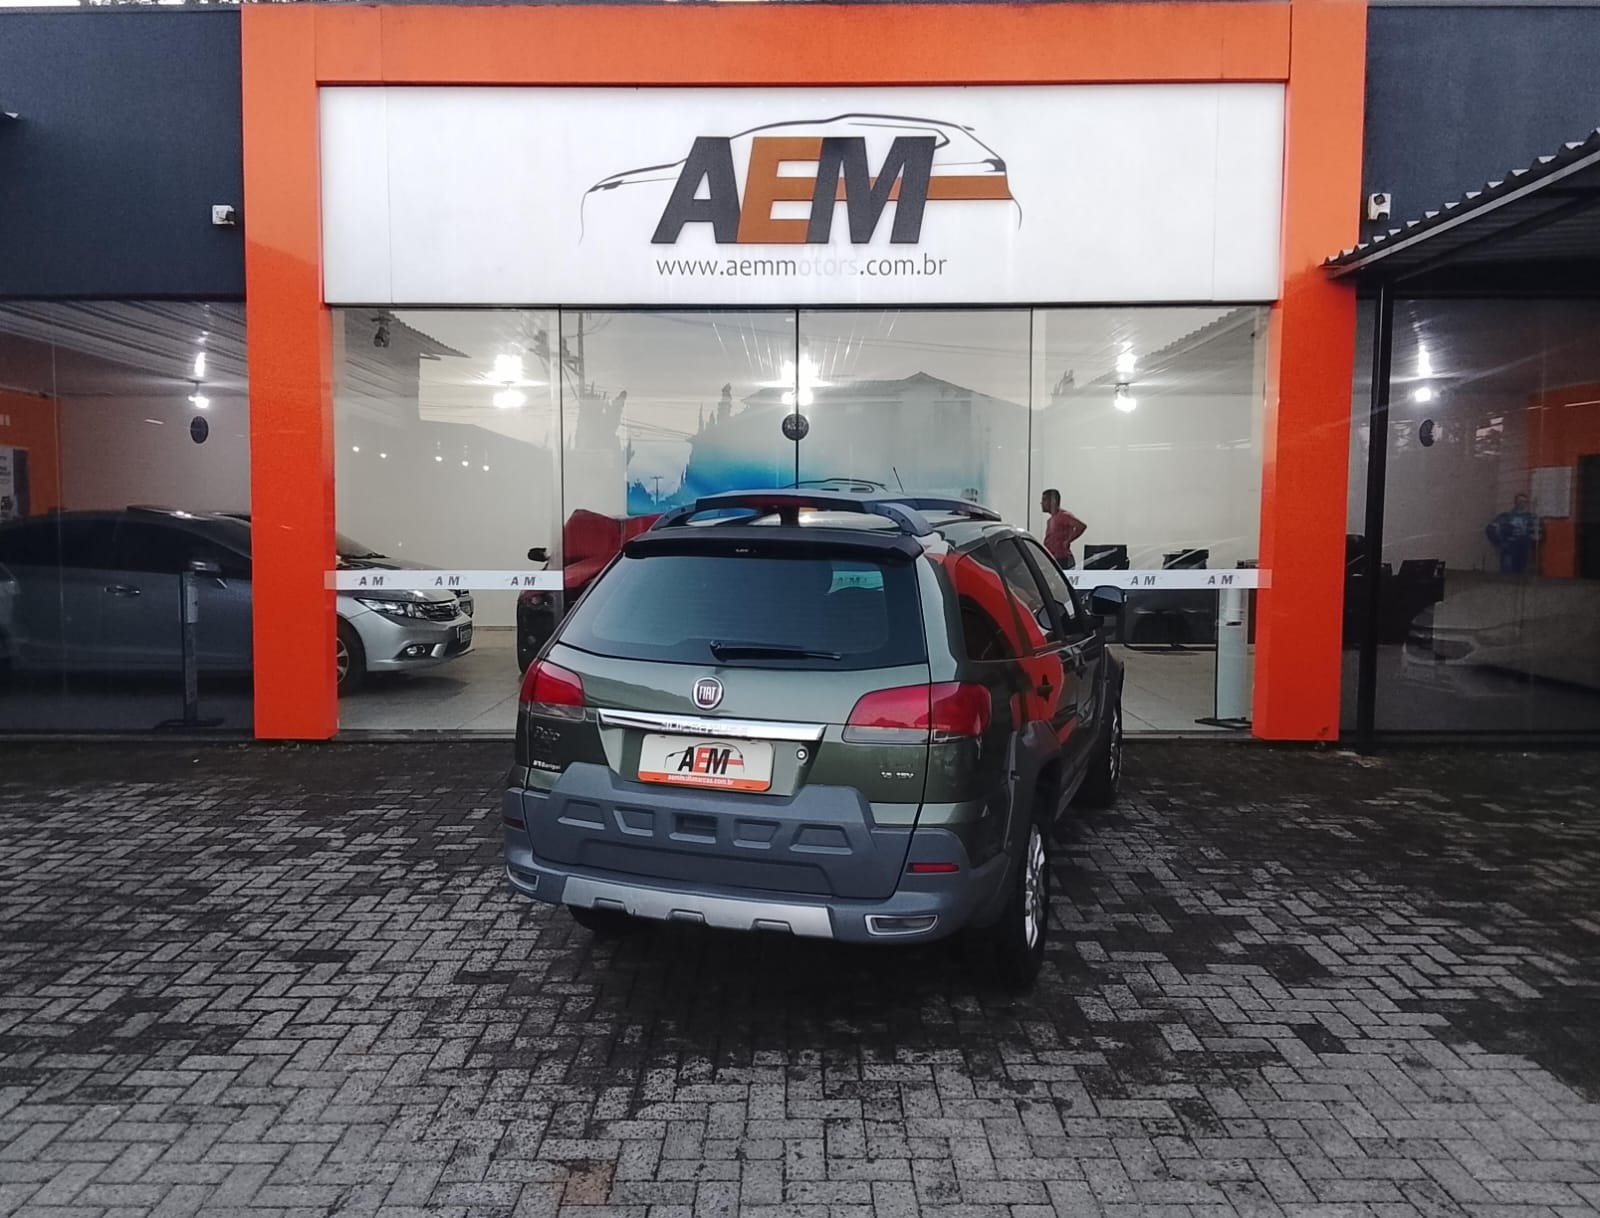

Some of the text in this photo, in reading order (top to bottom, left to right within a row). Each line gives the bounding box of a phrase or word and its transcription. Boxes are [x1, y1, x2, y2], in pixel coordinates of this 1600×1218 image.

[650, 135, 937, 244] AEM
[656, 252, 948, 277] www.aemmotors.com.br
[698, 686, 716, 701] FIAT
[677, 746, 730, 775] AEM
